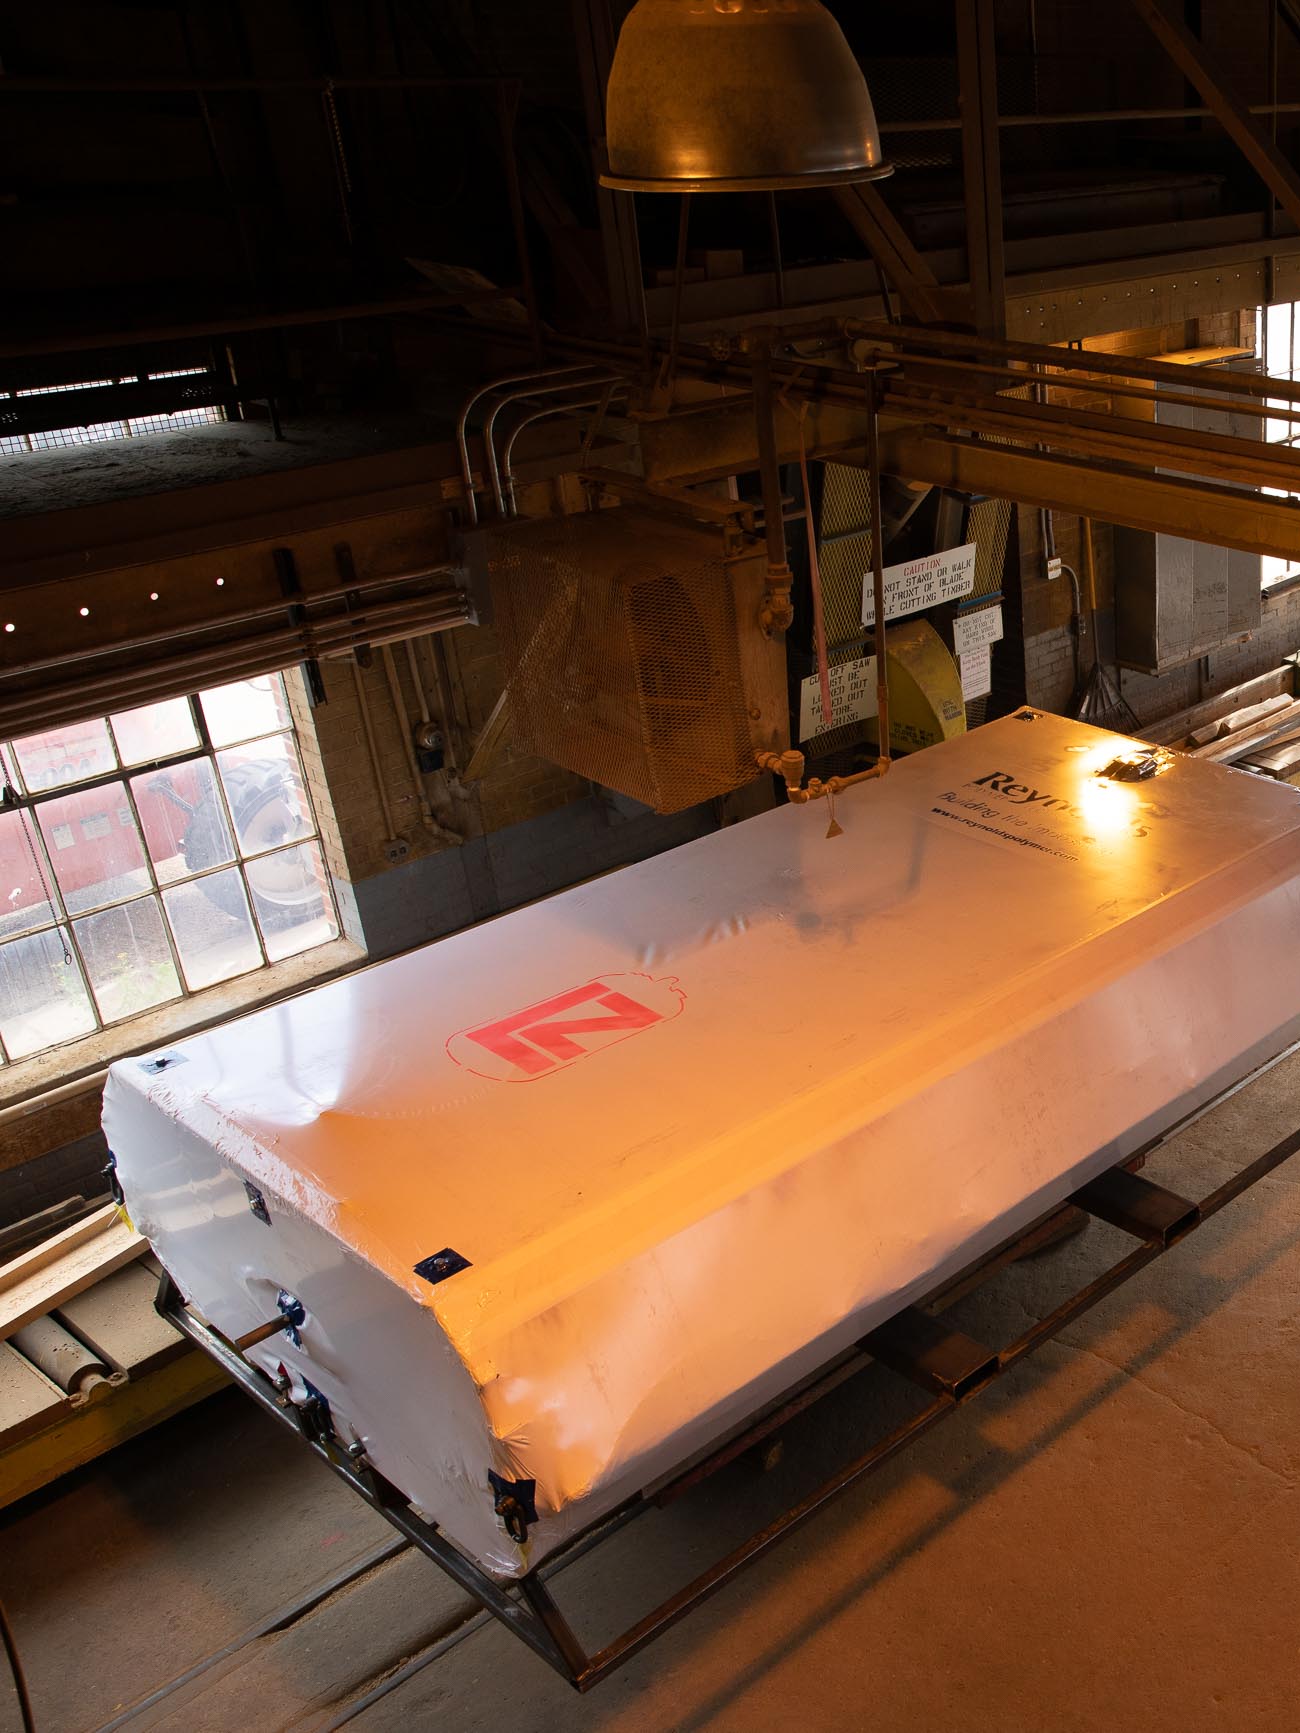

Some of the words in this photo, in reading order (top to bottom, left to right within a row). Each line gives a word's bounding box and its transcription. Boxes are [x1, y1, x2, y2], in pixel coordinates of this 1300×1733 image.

[884, 580, 901, 593] NOT
[906, 572, 933, 587] STAND
[937, 567, 948, 577] OR
[952, 558, 972, 572] WALK
[904, 558, 941, 576] CAUTION
[892, 586, 919, 603] FRONT
[924, 581, 934, 592] OF
[939, 572, 964, 588] BLADE
[900, 592, 936, 611] CUTTING
[942, 580, 971, 597] TIMBER
[830, 664, 847, 677] OFF
[852, 657, 871, 670] SAW
[848, 670, 860, 682] BE
[850, 678, 868, 691] OUT
[847, 690, 865, 702] OUT
[936, 791, 1001, 819] Building
[1002, 814, 1028, 827] the
